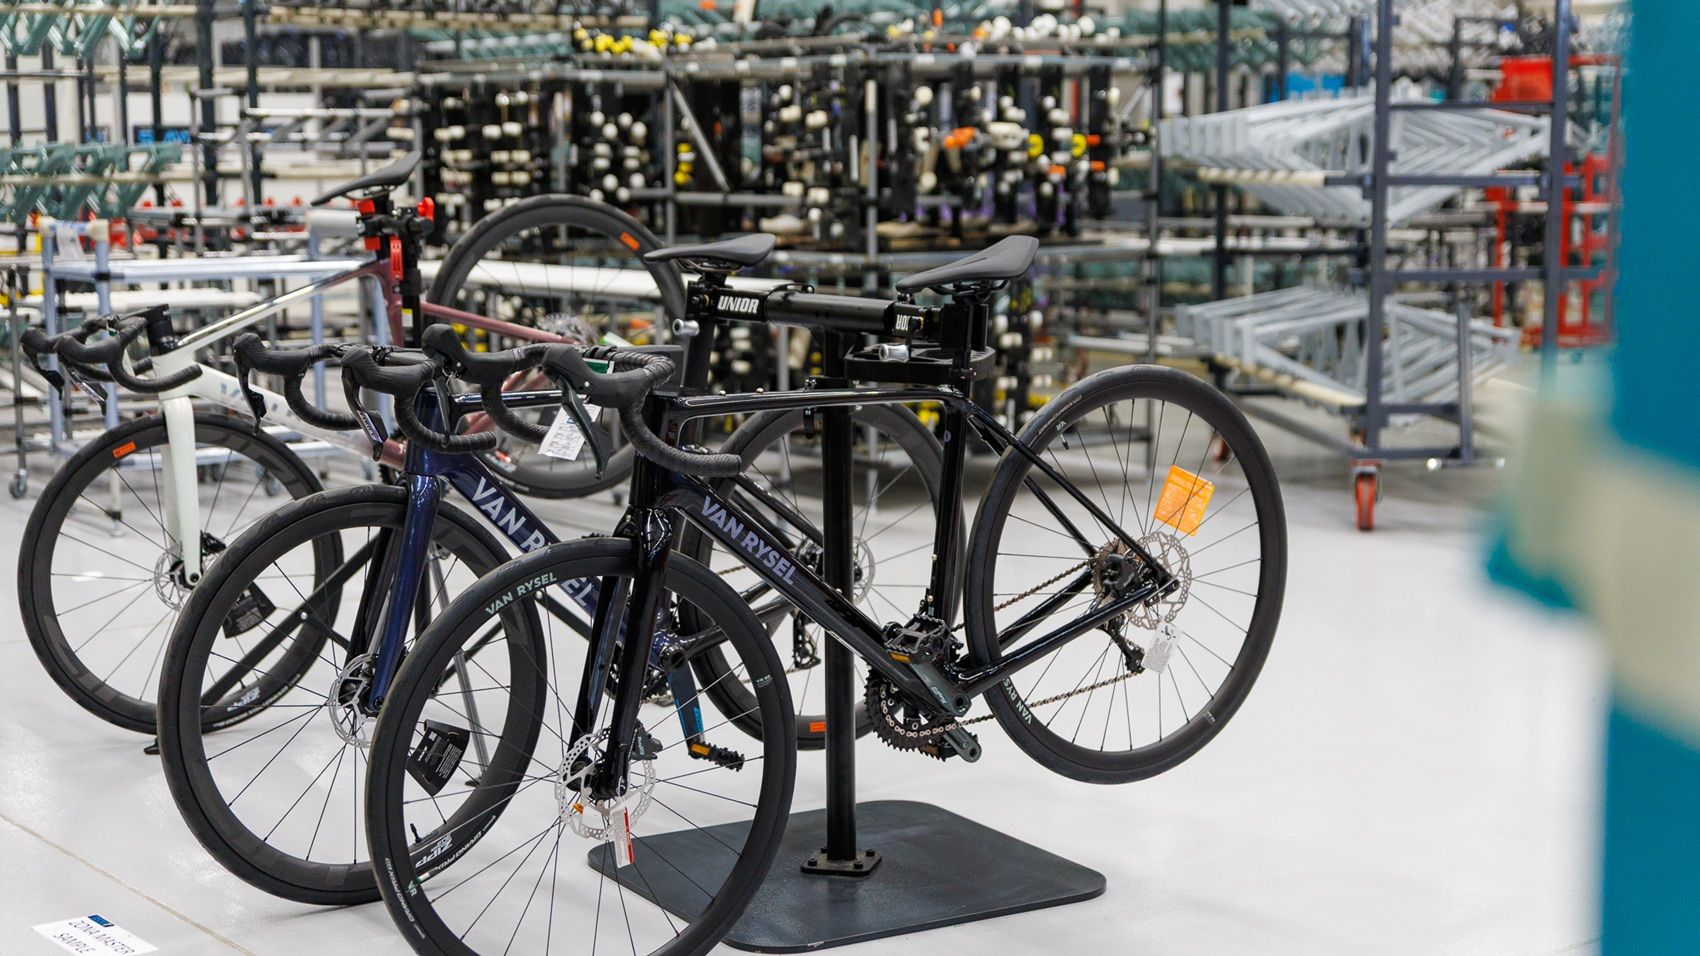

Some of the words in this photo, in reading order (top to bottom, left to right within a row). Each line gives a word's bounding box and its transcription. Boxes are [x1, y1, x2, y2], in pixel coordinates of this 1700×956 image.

[717, 295, 760, 314] UNIOR
[472, 476, 526, 535] VAN
[701, 495, 744, 540] VAN
[740, 530, 796, 585] RYSEL
[485, 591, 513, 615] VAN
[516, 572, 558, 597] RYSEL
[1003, 678, 1018, 701] RYS
[1015, 700, 1032, 724] VAN
[52, 932, 96, 954] SAMPLE
[94, 932, 135, 955] MASTER
